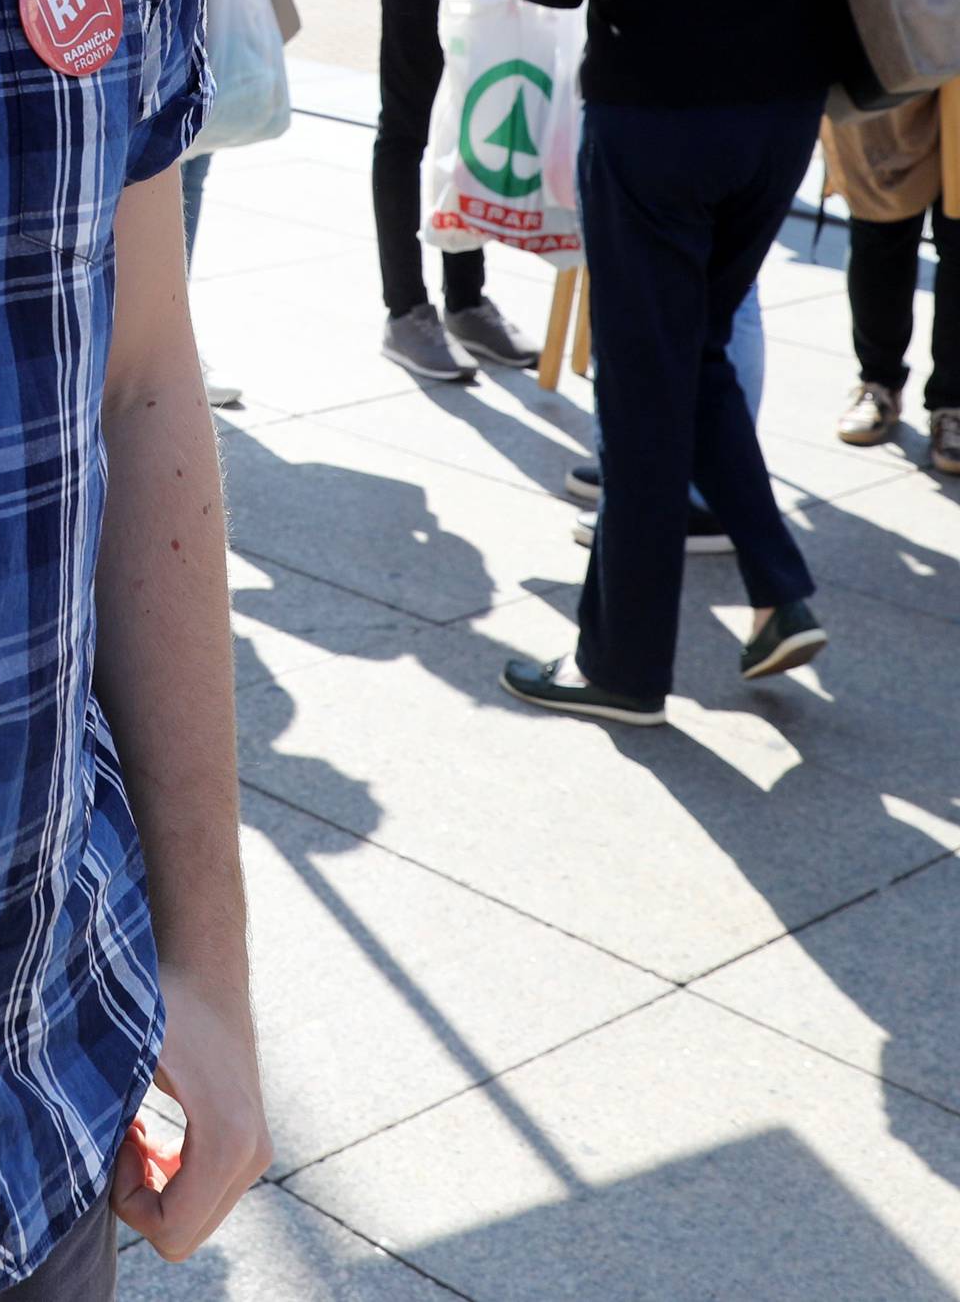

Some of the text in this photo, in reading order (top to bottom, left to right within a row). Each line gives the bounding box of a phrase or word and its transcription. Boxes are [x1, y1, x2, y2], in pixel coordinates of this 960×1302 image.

[63, 27, 116, 64] RADNIČKA
[73, 43, 114, 72] FRONTA
[467, 199, 540, 229] SPAR
